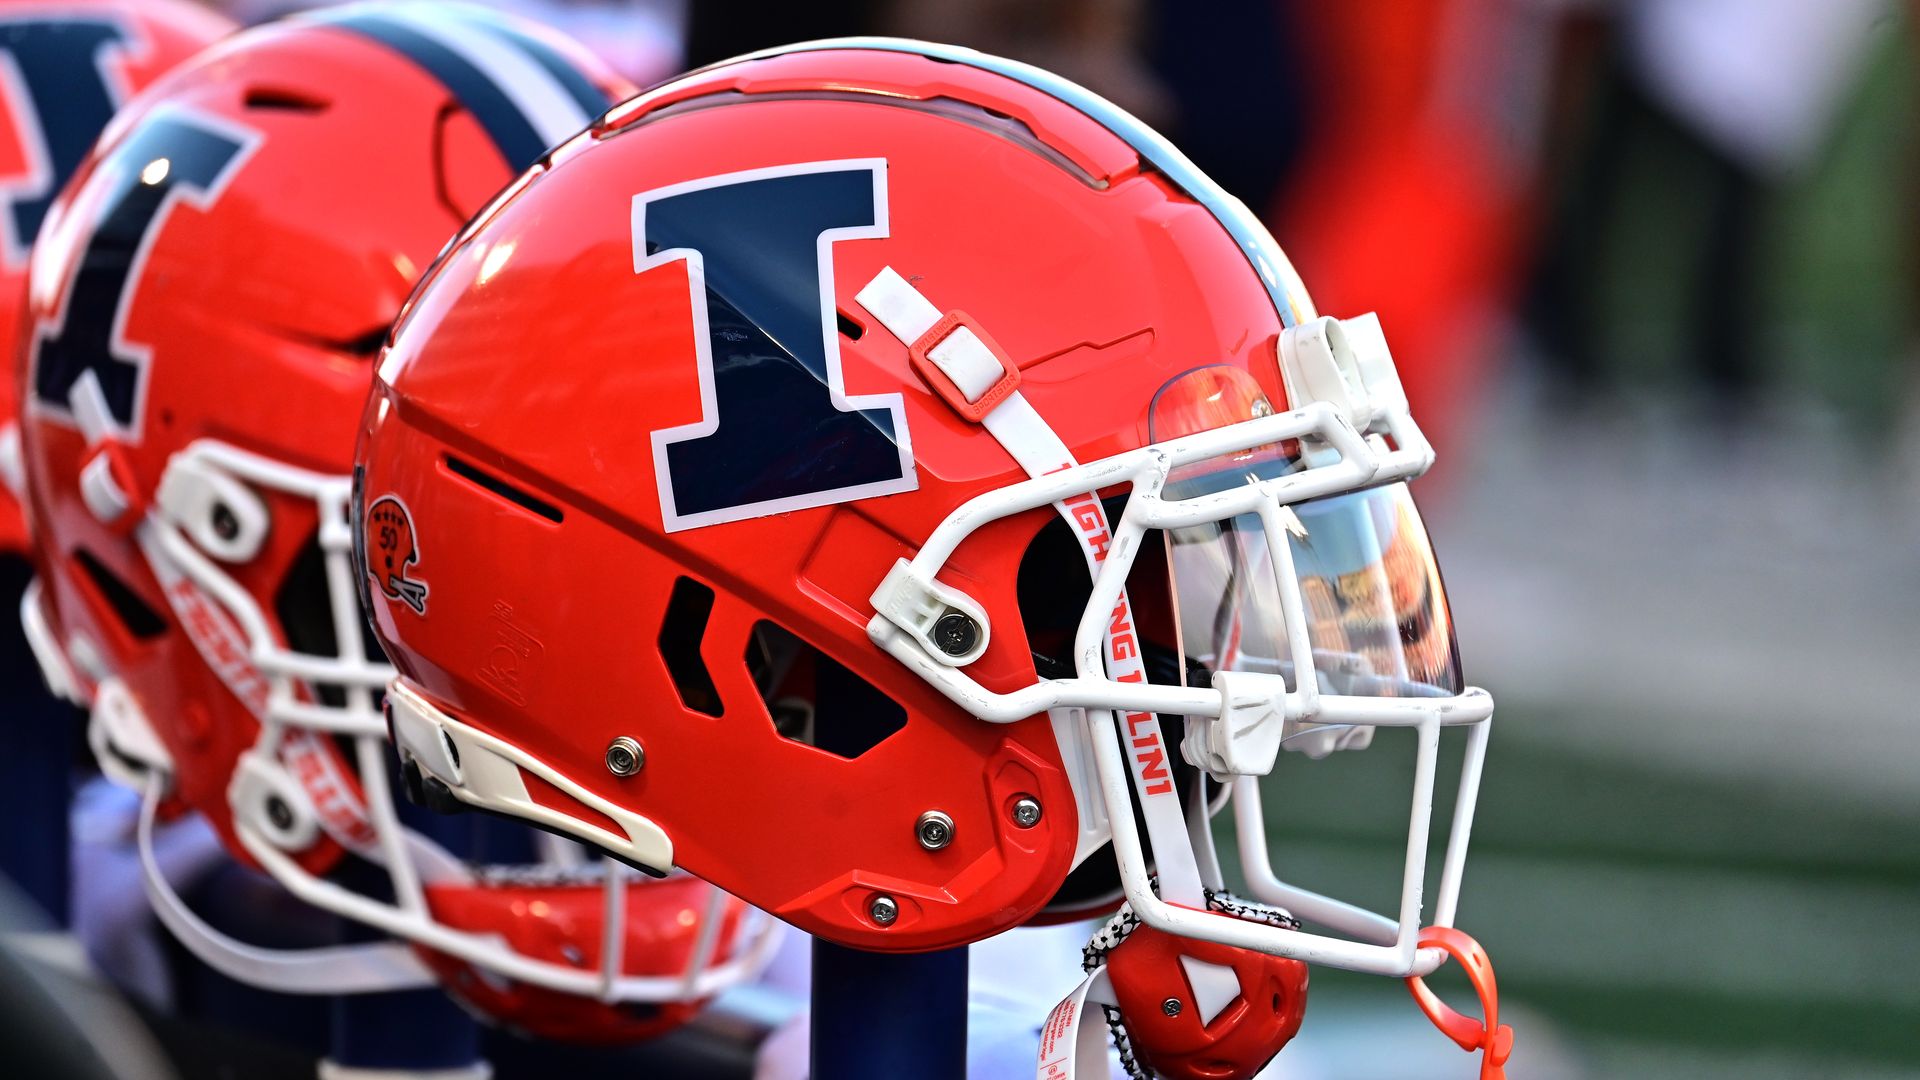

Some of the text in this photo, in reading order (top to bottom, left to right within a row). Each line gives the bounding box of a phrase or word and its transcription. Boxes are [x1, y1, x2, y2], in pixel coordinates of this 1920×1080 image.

[631, 157, 918, 533] I
[379, 525, 398, 551] 50
[1116, 669, 1172, 796] ILINI
